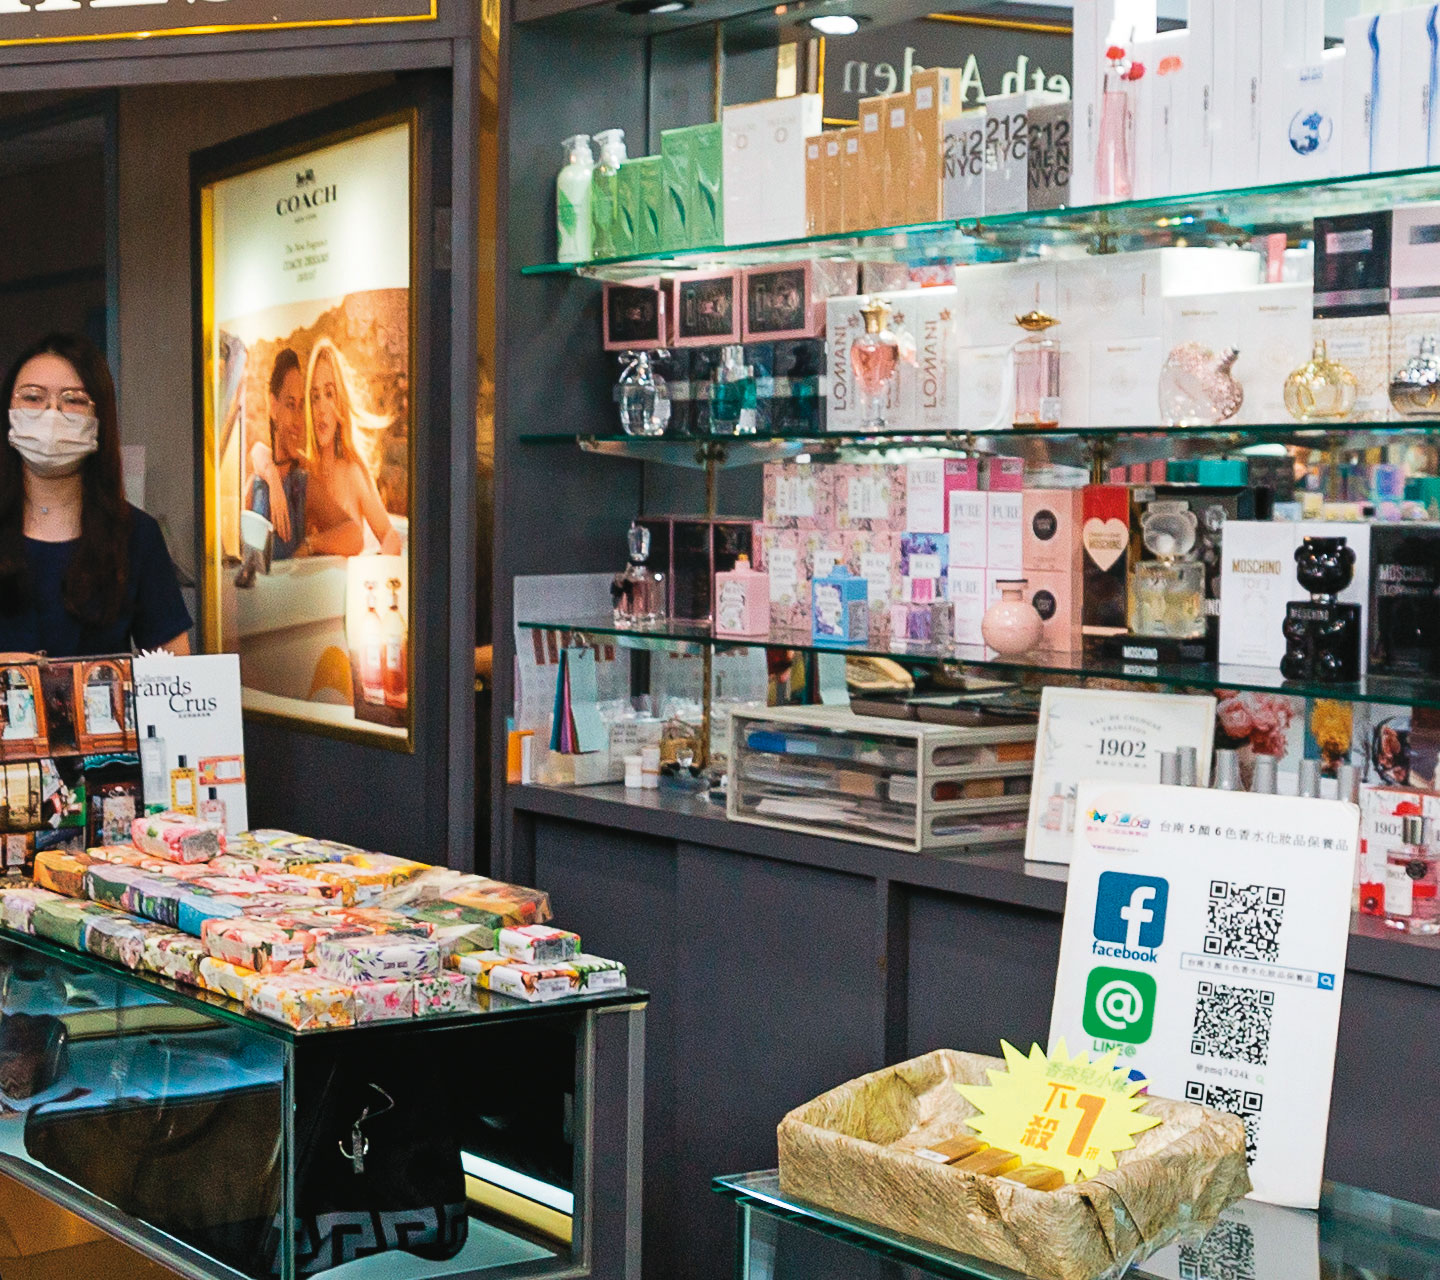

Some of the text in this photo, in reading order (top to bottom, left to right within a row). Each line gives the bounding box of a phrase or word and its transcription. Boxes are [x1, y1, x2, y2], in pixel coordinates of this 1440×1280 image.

[986, 114, 1028, 143] 212
[1028, 121, 1070, 150] 212
[1028, 166, 1069, 189] NYC
[276, 183, 338, 218] COACH
[832, 325, 848, 410] LOMANI
[923, 320, 938, 409] LOMANI
[1232, 559, 1281, 575] MOSCHINO
[169, 694, 217, 713] Crus
[1098, 738, 1146, 758] 1902
[1092, 940, 1158, 964] facebook
[1093, 1039, 1137, 1058] LINE@
